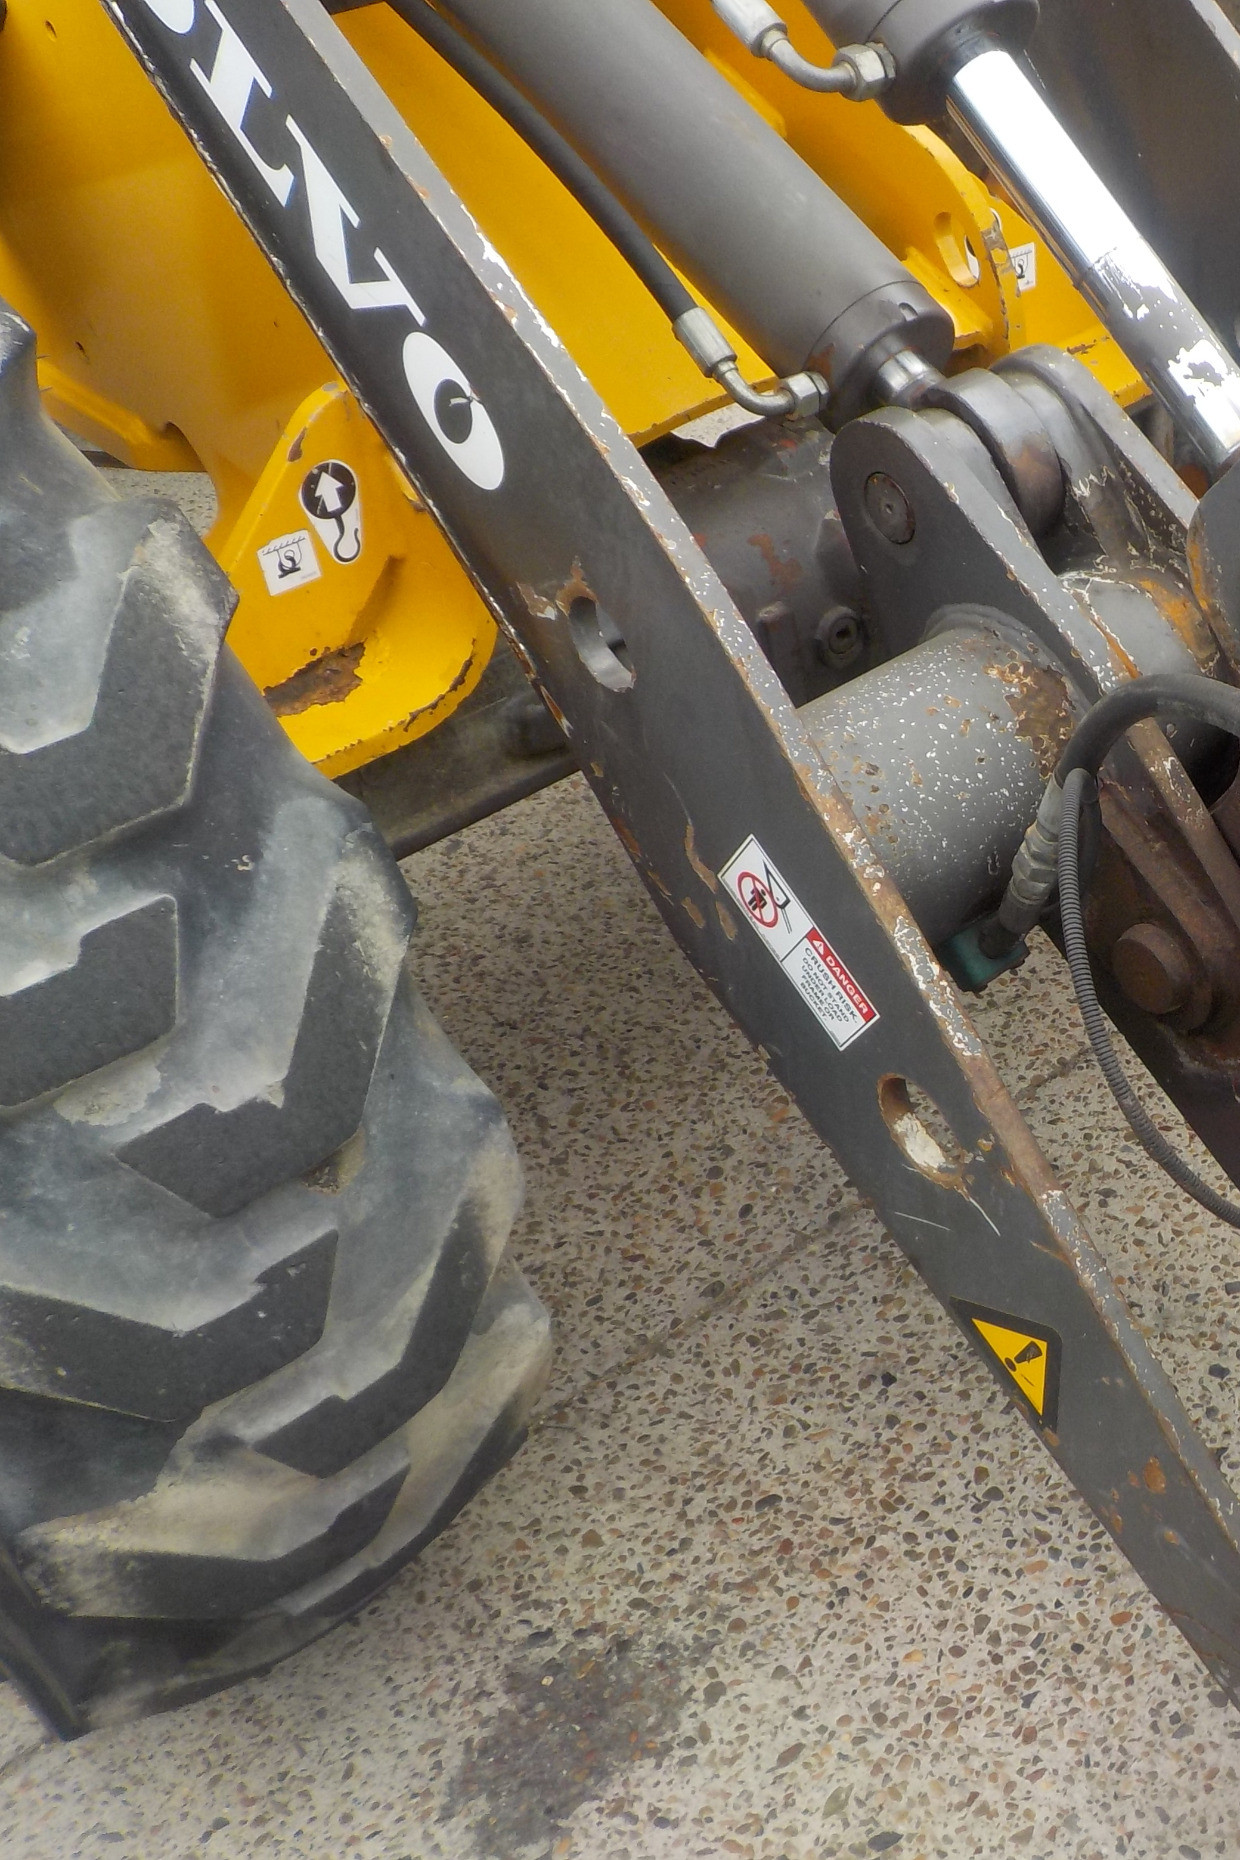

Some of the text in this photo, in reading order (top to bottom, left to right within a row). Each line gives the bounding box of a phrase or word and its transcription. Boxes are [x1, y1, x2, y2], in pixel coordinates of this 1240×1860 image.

[145, 0, 505, 490] LVO
[801, 964, 825, 996] UNDER
[824, 997, 843, 1022] LOAD
[801, 974, 824, 1005] FRAME
[823, 1006, 835, 1020] OR
[802, 957, 814, 971] DO
[813, 972, 828, 990] NOT
[826, 992, 849, 1022] STAND
[804, 947, 836, 990] CRUSH
[835, 990, 858, 1023] RISK.
[825, 955, 868, 1013] DANGER
